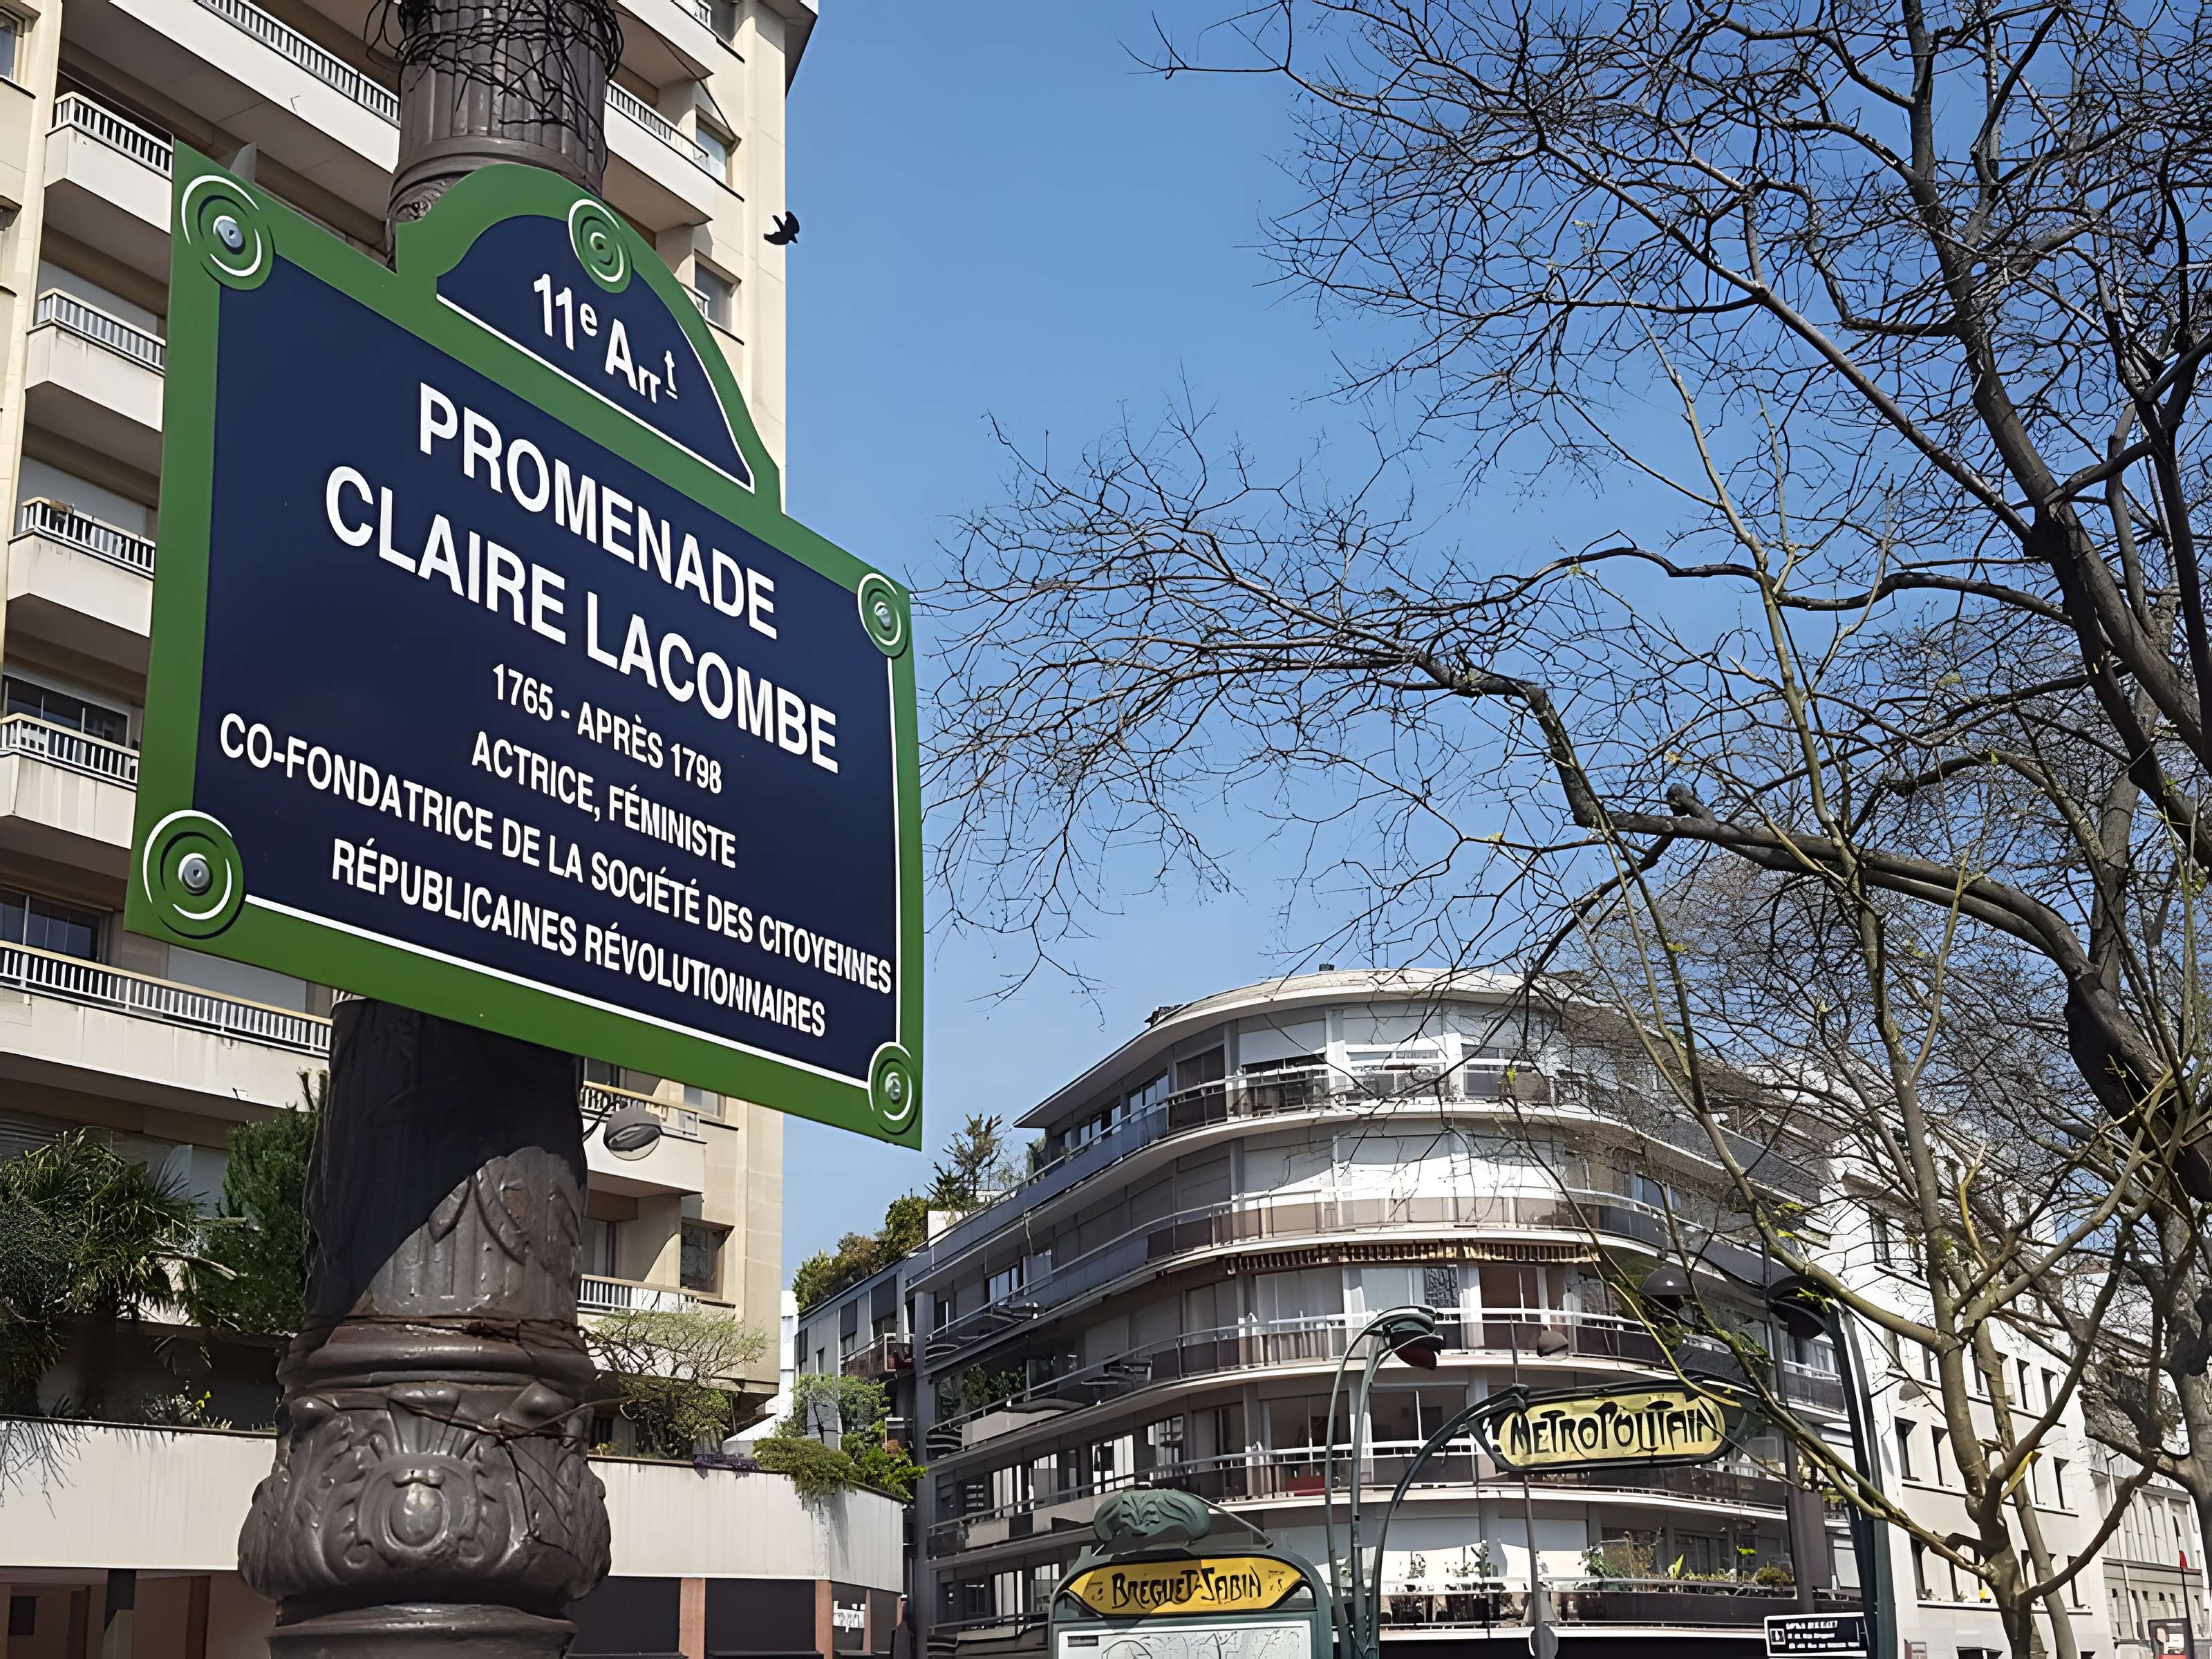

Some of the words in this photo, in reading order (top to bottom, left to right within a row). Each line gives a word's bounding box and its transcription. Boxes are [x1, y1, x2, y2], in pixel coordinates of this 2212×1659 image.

[533, 273, 598, 350] 11e
[420, 382, 778, 640] PROMENADE
[326, 465, 566, 646] CLAIRE
[587, 590, 838, 774] LACOMBE
[471, 731, 601, 823] ACTRICE,
[609, 784, 736, 869] FÉMINISTE
[492, 664, 554, 721] 1765
[577, 702, 664, 769] APRÈS
[671, 743, 722, 794] 1798
[220, 713, 494, 850] CO-FONDATRICE
[502, 818, 541, 868] DE
[549, 834, 583, 883] LA
[591, 852, 700, 925] SOCIÉTÉ
[706, 894, 753, 944] DES
[759, 915, 892, 995] CITOYENNES
[332, 837, 577, 957] RÉPUBLICAINES
[584, 921, 826, 1038] RÉVOLUTIONNAIRES
